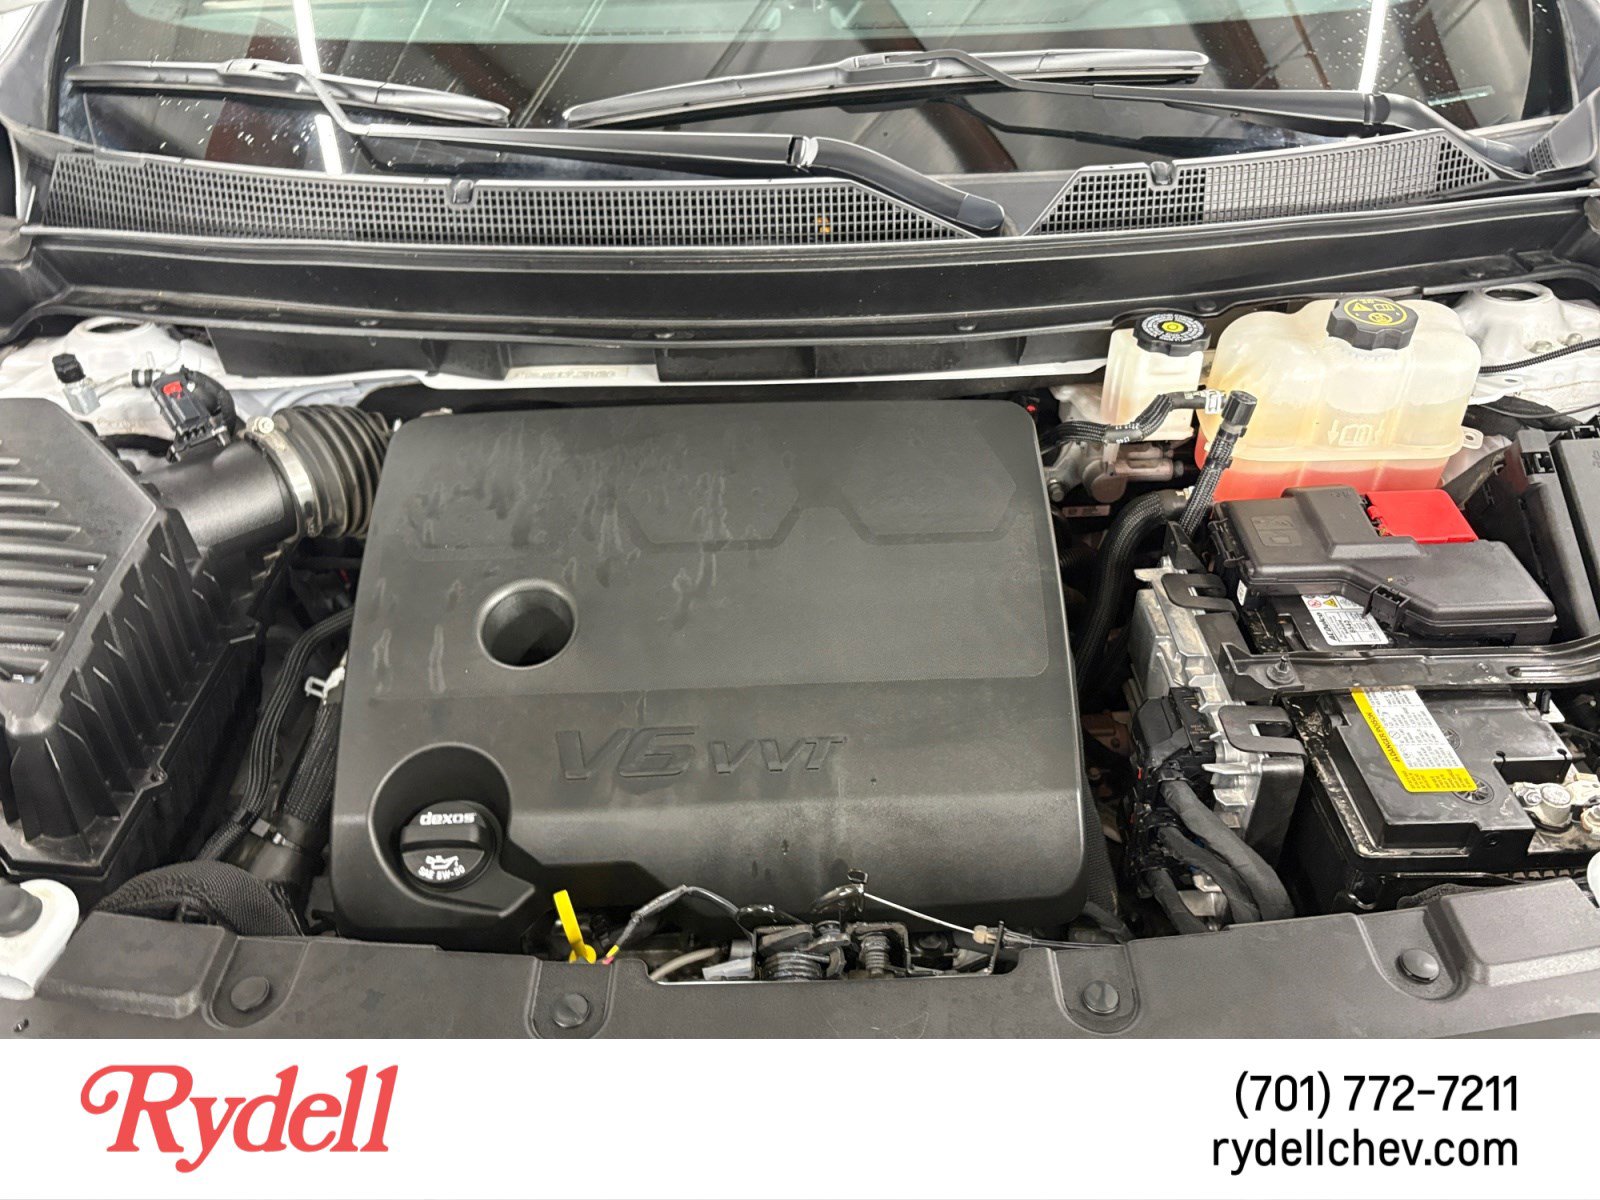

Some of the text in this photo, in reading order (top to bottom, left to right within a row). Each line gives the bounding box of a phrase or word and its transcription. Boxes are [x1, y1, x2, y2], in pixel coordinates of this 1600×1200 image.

[555, 725, 845, 780] V6 VVT
[1379, 733, 1396, 757] DANGER
[419, 811, 476, 826] dexos
[418, 866, 435, 880] SAE
